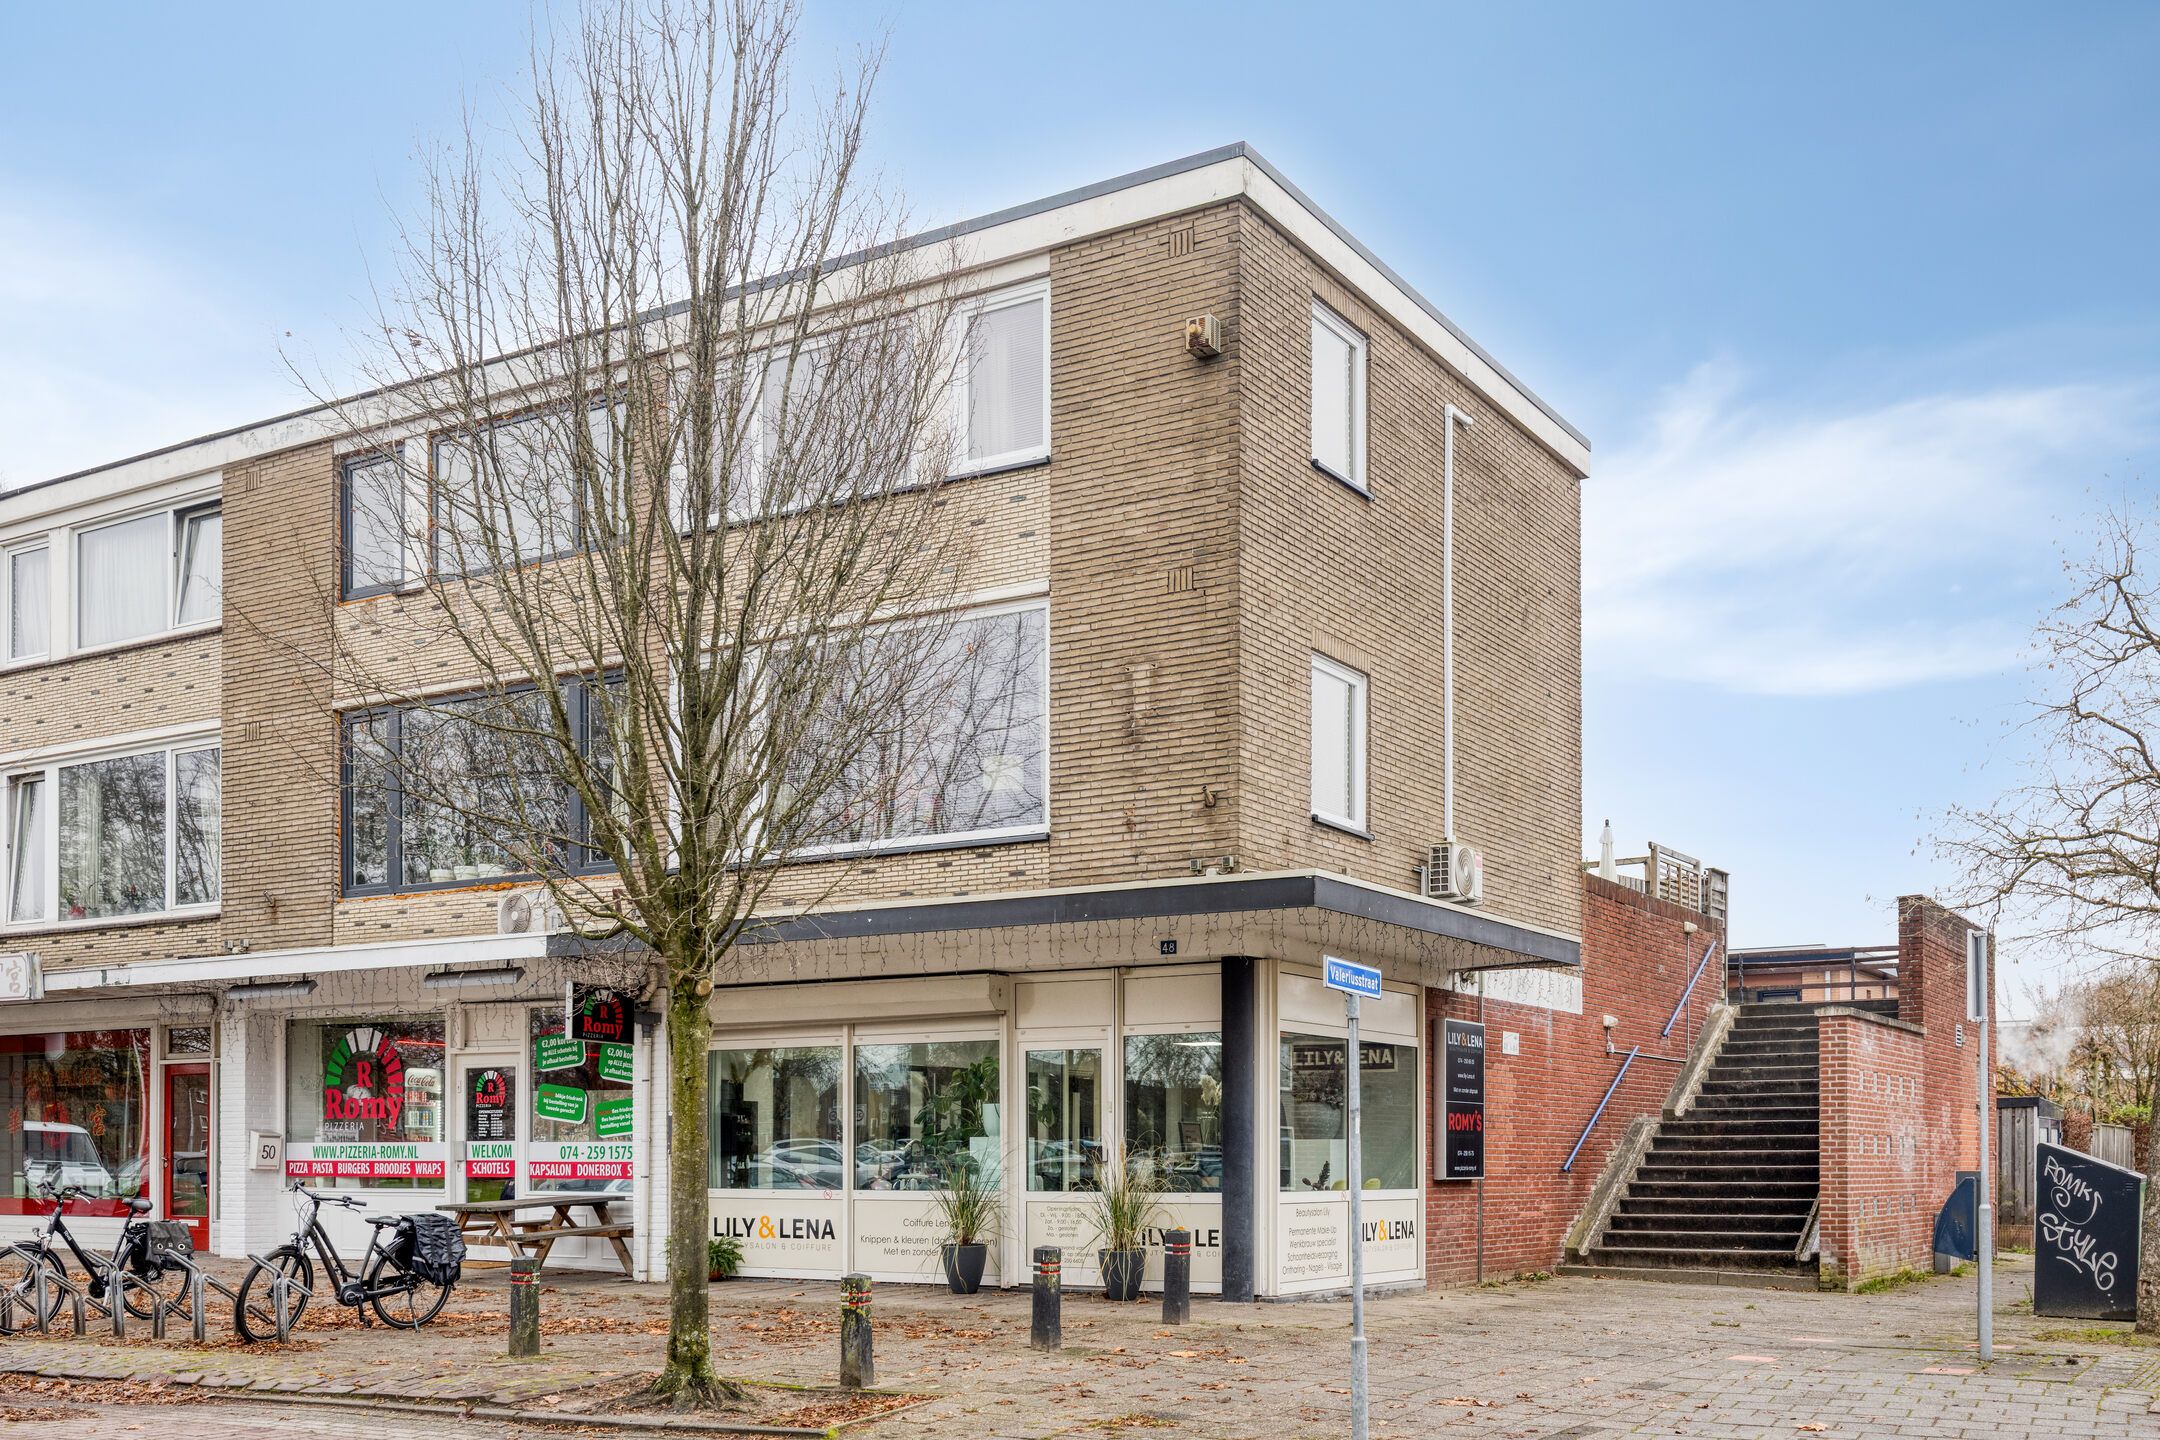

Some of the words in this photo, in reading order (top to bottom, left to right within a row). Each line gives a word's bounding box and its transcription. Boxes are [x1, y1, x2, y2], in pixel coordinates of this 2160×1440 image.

[1162, 942, 1175, 953] 48
[1330, 965, 1378, 991] Valeriusstraat
[599, 1005, 608, 1019] R
[583, 1015, 623, 1040] Romy
[357, 1061, 372, 1088] R
[487, 1082, 494, 1093] R
[475, 1092, 505, 1108] Romy
[325, 1088, 404, 1130] Romy
[324, 1121, 364, 1131] PIZZERIA
[1448, 1110, 1482, 1132] ROMY'S
[261, 1145, 276, 1160] 50
[312, 1145, 419, 1159] WWW.PIZZERIA-ROMY.NL
[472, 1144, 512, 1158] WELKOM
[560, 1145, 579, 1160] 074
[587, 1145, 605, 1160] 259
[608, 1145, 633, 1160] 1575
[289, 1162, 308, 1174] PIZZA
[312, 1162, 334, 1174] PASTA
[337, 1163, 370, 1174] BURGERS
[374, 1163, 411, 1174] BROODJES
[415, 1163, 442, 1174] WRAPS
[472, 1162, 510, 1174] SCHOTELS
[529, 1163, 572, 1176] KAPSALON
[577, 1163, 622, 1176] DONERBOX
[627, 1163, 633, 1176] S
[903, 1218, 934, 1228] Coiffure
[935, 1218, 950, 1228] Len
[1362, 1219, 1415, 1241] ILY&LENA
[860, 1234, 892, 1245] Knippen
[894, 1235, 899, 1243] &
[901, 1235, 930, 1244] kleuren
[744, 1242, 777, 1250] YSALON
[790, 1243, 832, 1252] COIFFURE
[884, 1247, 899, 1256] Met
[900, 1248, 911, 1256] en
[912, 1247, 939, 1257] zonder
